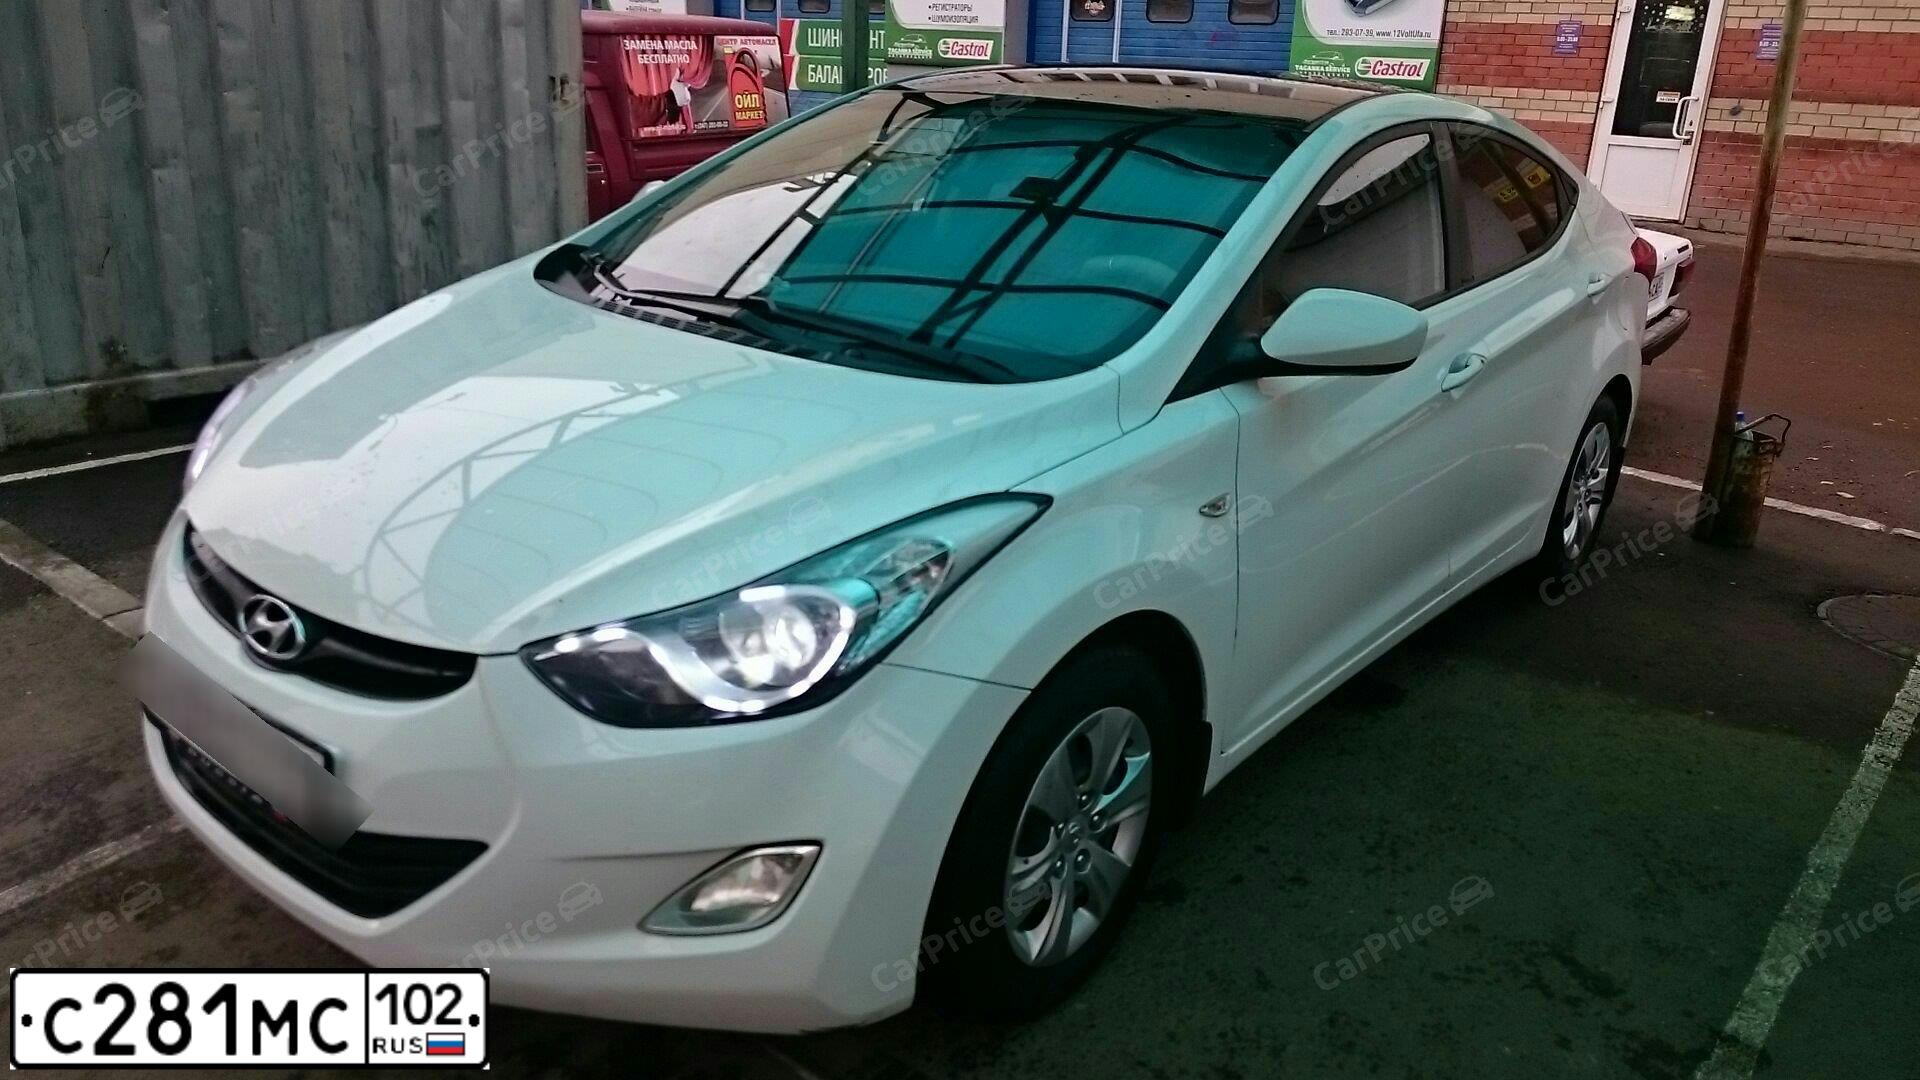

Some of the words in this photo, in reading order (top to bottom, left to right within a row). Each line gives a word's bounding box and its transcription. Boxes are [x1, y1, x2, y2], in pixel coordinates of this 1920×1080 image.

[931, 3, 973, 12] РЕГИСТРАТОРЫ
[931, 14, 979, 23] ШУМОИЗОЛЯЦИЯ
[623, 39, 664, 51] ЗАМЕНА
[664, 39, 698, 50] МАСЛА
[951, 41, 988, 57] Castrol
[637, 53, 690, 64] БЕСПЛАТНО
[1371, 60, 1424, 77] Castrol
[735, 91, 760, 108] ОЙЛ
[735, 109, 764, 120] МАРКЕТ
